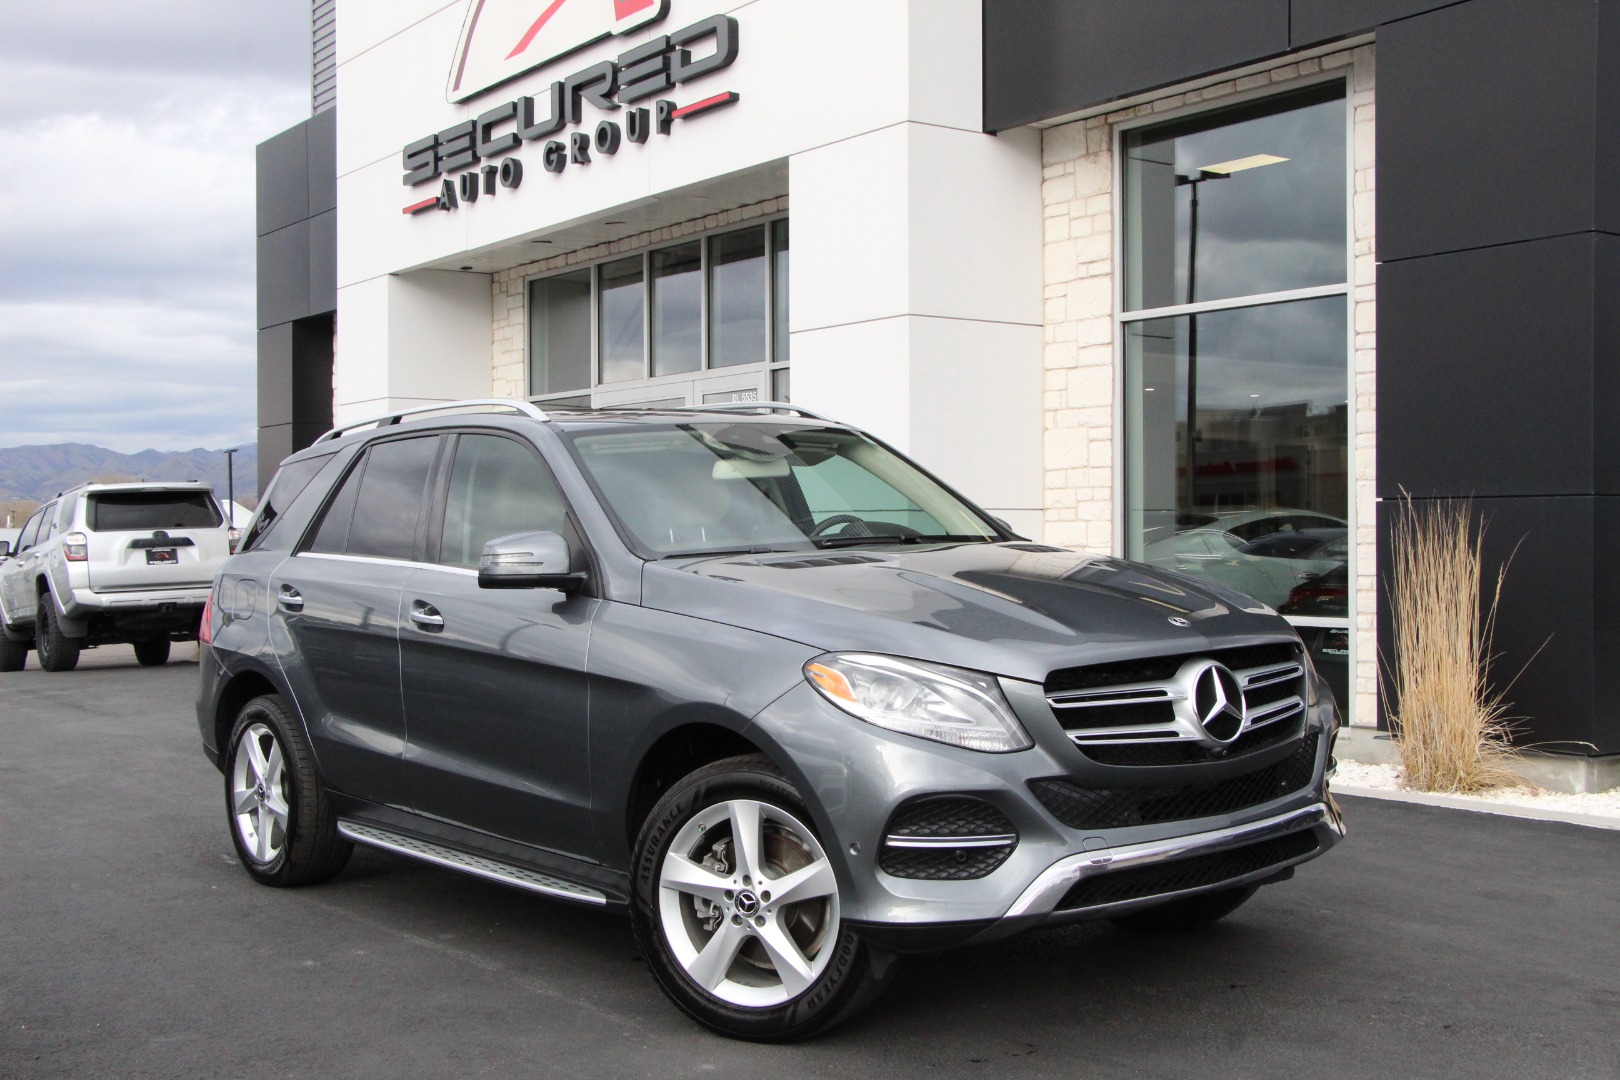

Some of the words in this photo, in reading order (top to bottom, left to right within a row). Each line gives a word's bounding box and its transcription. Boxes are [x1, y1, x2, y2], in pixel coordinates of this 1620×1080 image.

[403, 14, 739, 186] SECURED
[438, 157, 523, 212] AUTO
[543, 100, 677, 174] GROUP
[741, 391, 757, 402] 5535
[641, 802, 684, 886] ASSURANCE
[807, 925, 855, 1010] OODYEAR
